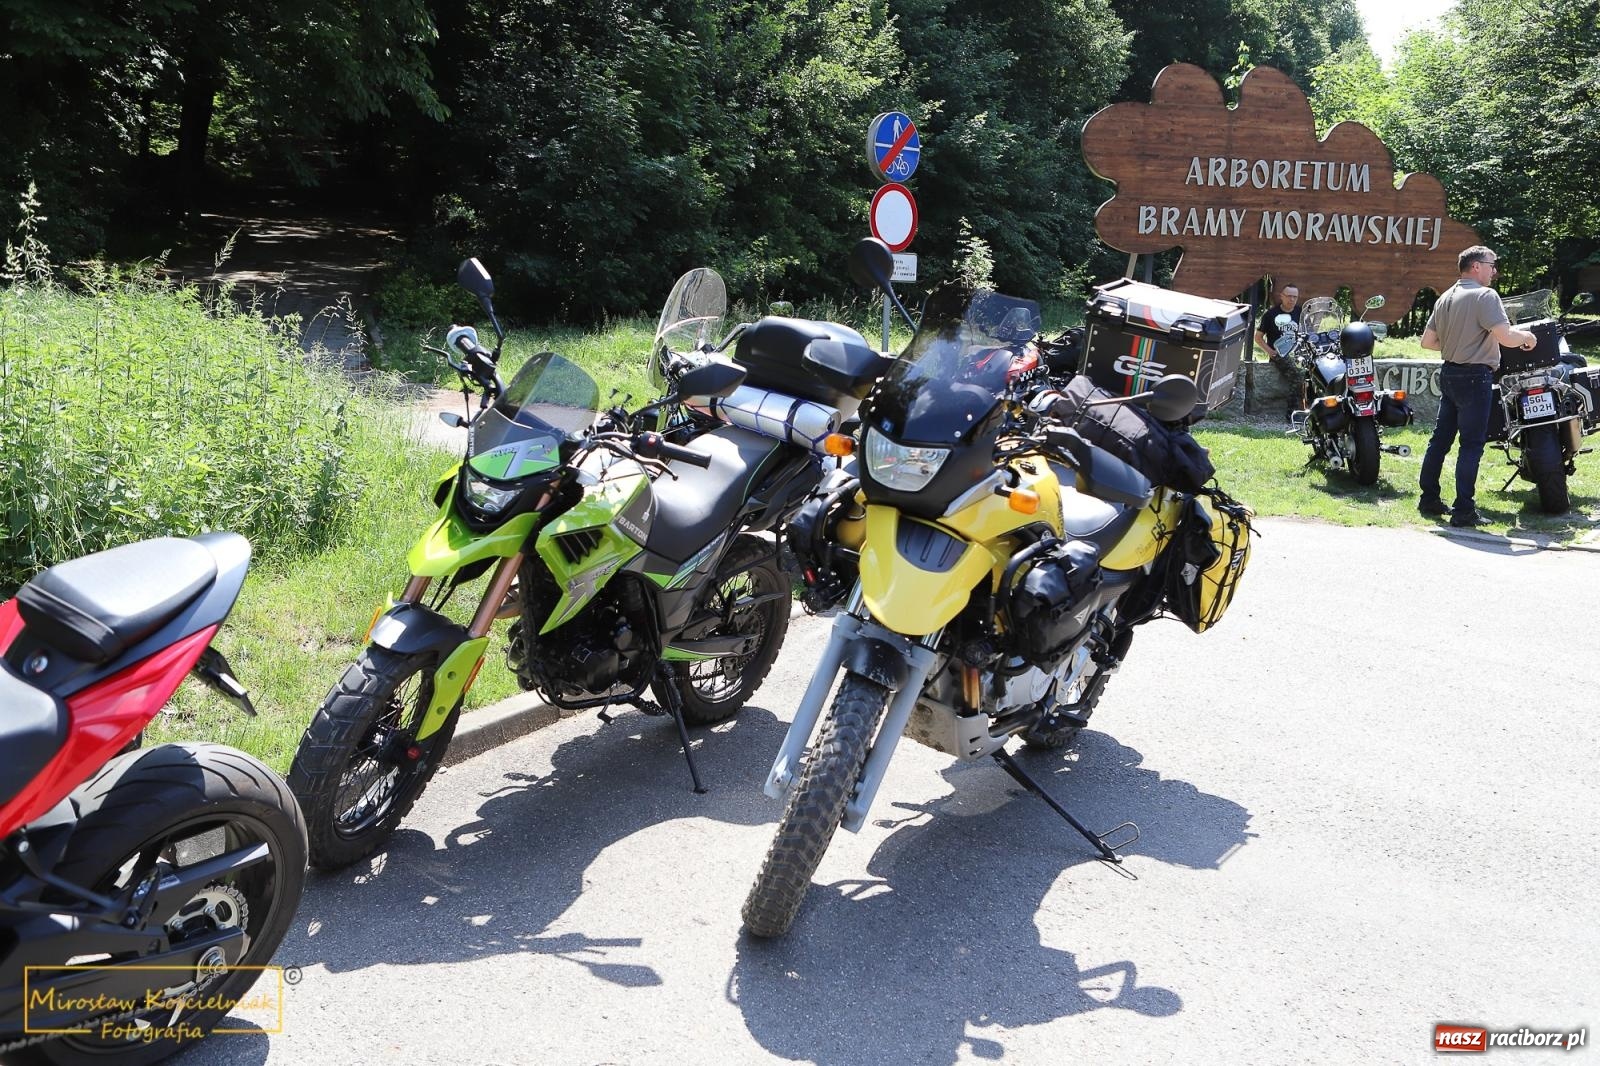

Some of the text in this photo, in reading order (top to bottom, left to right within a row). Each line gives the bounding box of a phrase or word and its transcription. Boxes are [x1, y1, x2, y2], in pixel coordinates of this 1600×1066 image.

[1185, 156, 1370, 193] ARBORETUM
[1138, 204, 1442, 251] BRAMY MORAWSKIEJ
[1113, 355, 1168, 382] GS
[1529, 395, 1547, 404] SGL
[618, 516, 648, 541] BARTON
